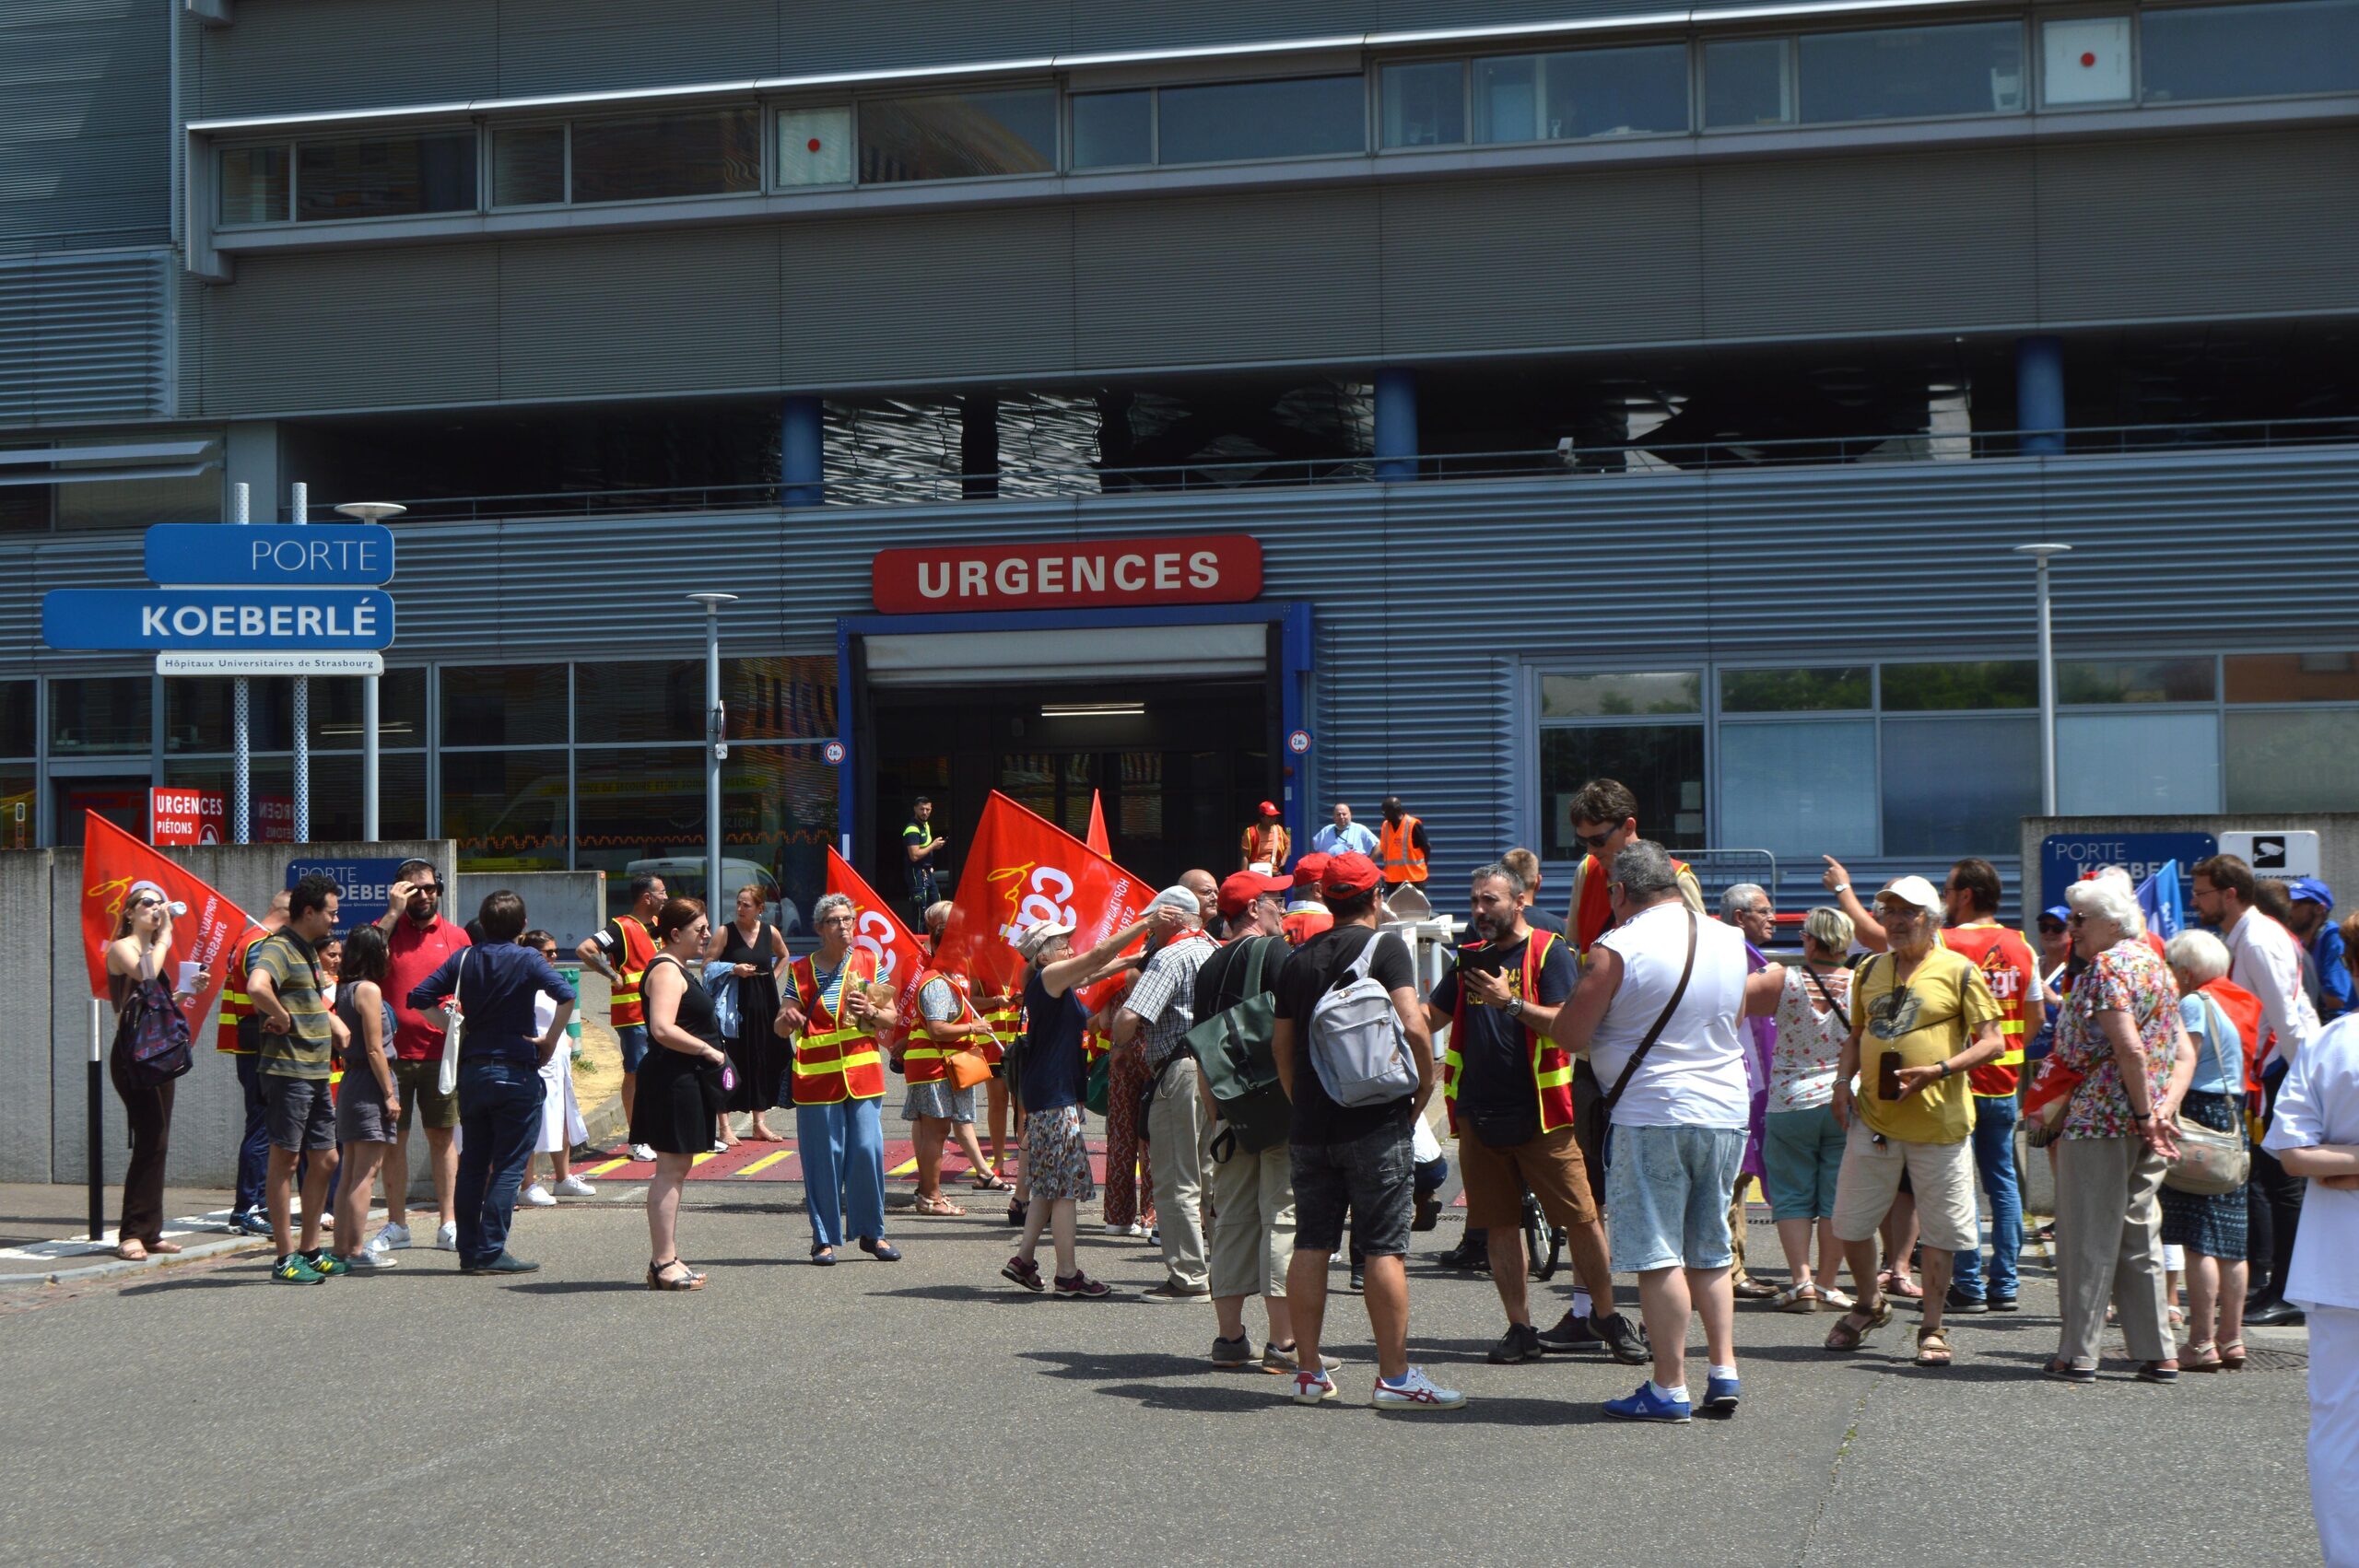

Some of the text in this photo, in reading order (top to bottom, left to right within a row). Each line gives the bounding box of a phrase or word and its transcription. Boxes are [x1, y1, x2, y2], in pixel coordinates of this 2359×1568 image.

[252, 541, 377, 571] PORTE
[917, 550, 1220, 599] URGENCES
[142, 596, 377, 637] KOEBERLÉ
[165, 659, 374, 669] Hôpitaux Universitaires de Strasbourg
[157, 795, 223, 815] URGENCES
[157, 818, 193, 835] PIÉTONS
[2055, 842, 2126, 860] PORTE
[299, 867, 357, 883] PORTE
[1982, 965, 2021, 999] cgt
